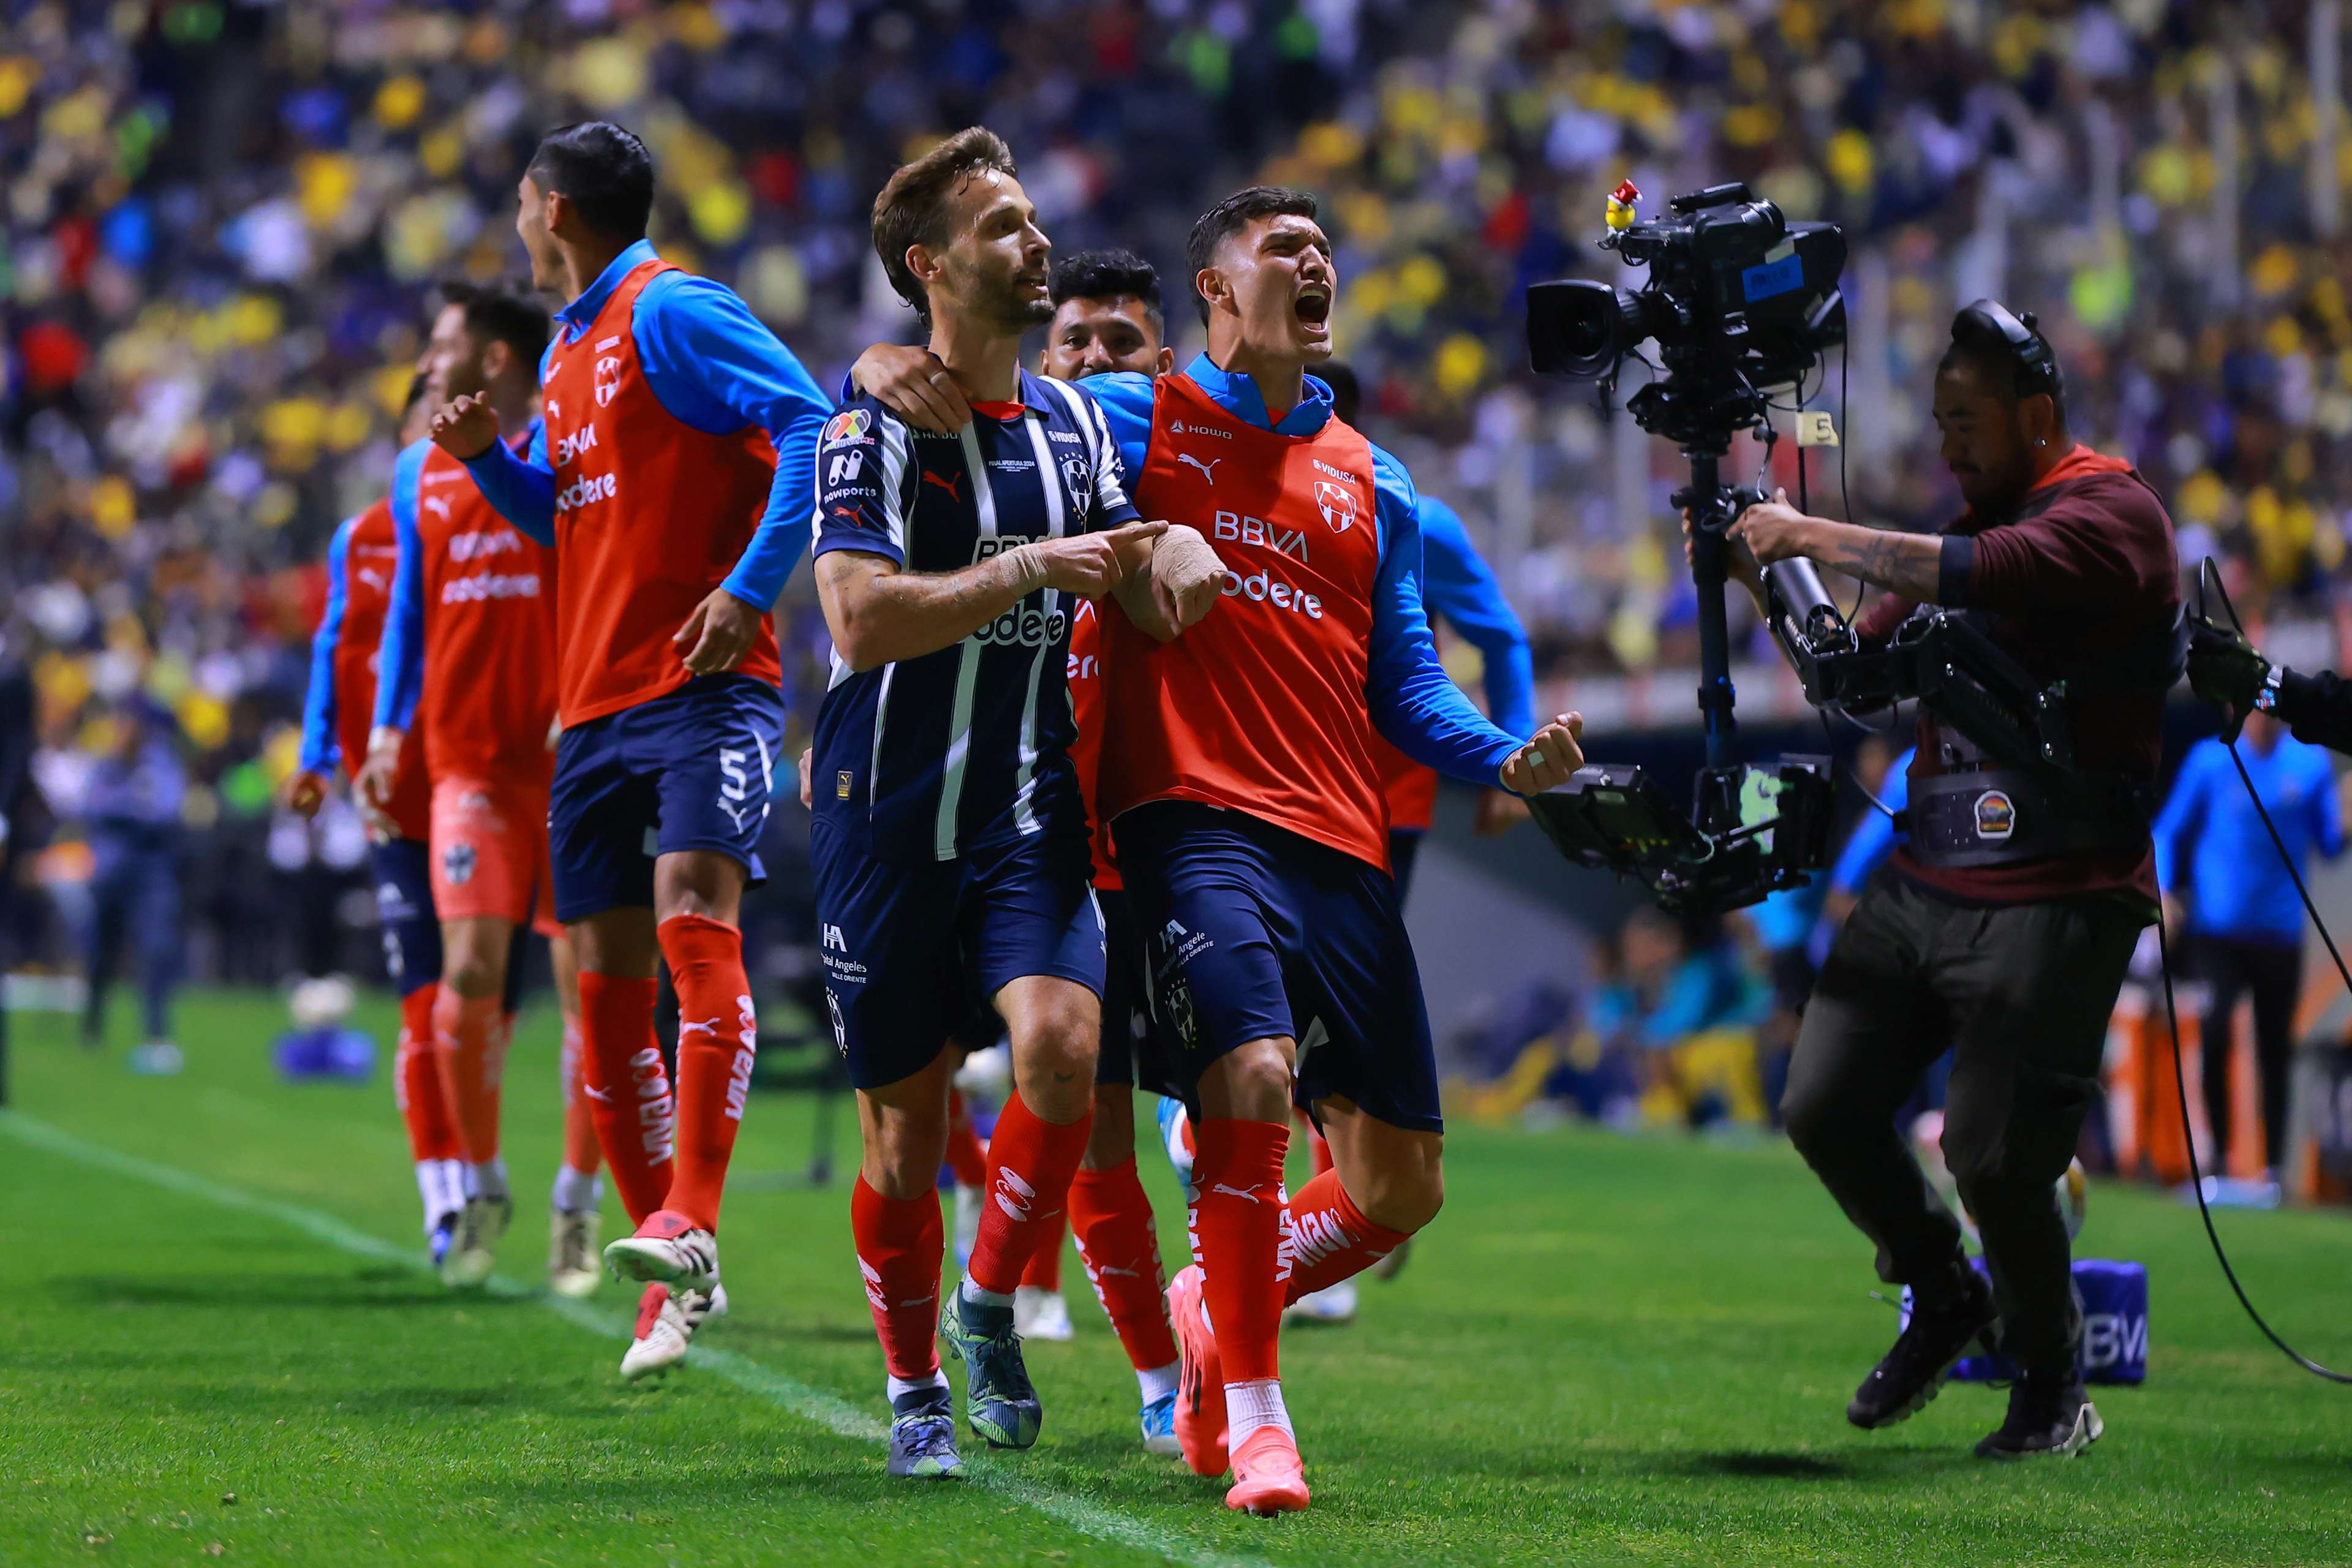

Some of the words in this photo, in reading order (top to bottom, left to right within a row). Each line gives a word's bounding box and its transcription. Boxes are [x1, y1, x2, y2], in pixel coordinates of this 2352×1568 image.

[1054, 431, 1082, 445] VIDUSA
[1188, 424, 1233, 440] HOWO
[1816, 418, 1831, 442] 5
[1321, 464, 1357, 485] VIDUSA
[823, 486, 877, 504] nowports
[1215, 510, 1308, 563] BBVA
[1221, 568, 1323, 619] odere
[973, 603, 1065, 643] odere
[719, 747, 746, 801] 5
[1189, 940, 1214, 957] ORIENTE
[834, 958, 867, 973] Angeles
[843, 975, 867, 984] ORIENTE
